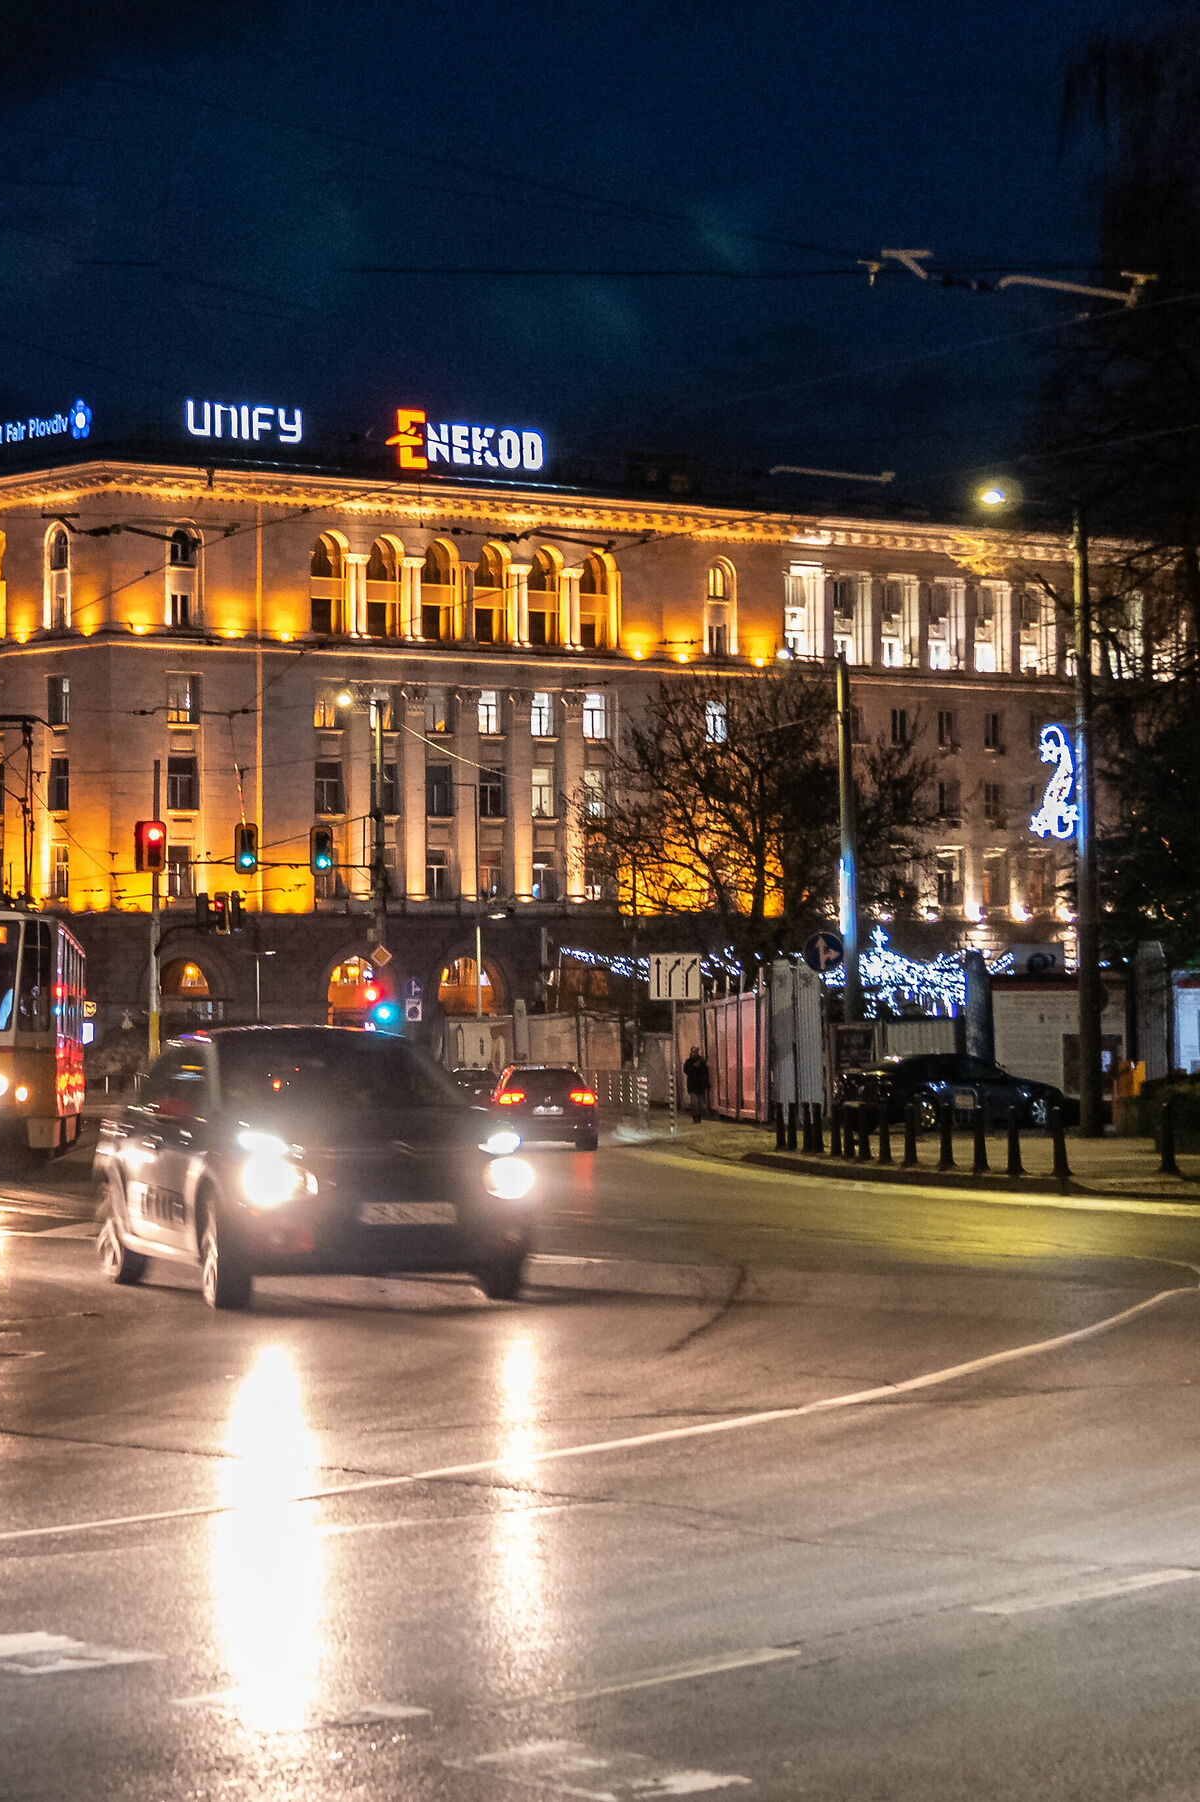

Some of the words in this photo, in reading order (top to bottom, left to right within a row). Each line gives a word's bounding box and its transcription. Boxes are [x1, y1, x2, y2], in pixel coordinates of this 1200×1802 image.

[5, 421, 27, 443] Fair
[28, 413, 68, 440] Plovdiv
[186, 399, 303, 444] UNIFY
